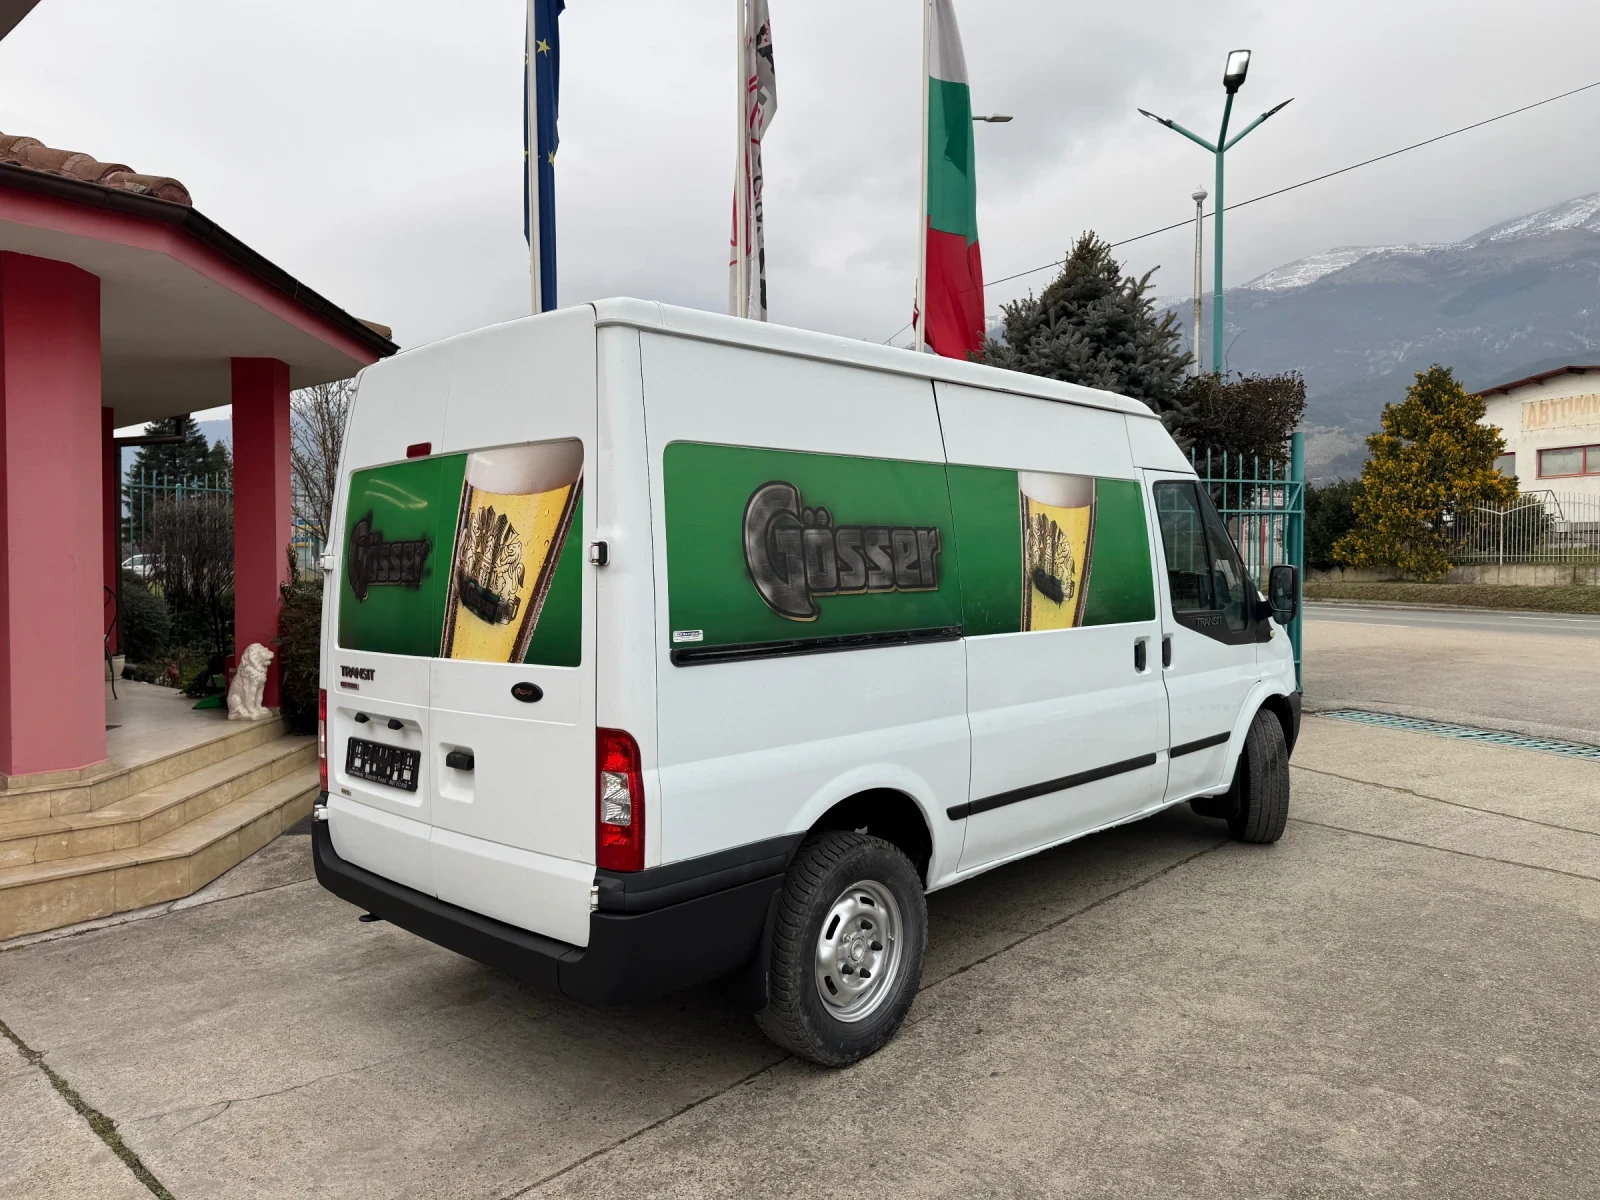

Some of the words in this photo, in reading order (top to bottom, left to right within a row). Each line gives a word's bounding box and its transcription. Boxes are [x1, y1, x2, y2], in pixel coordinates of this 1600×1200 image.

[743, 481, 940, 622] Gösser
[1195, 616, 1223, 627] TRANSIT
[340, 664, 376, 682] TRANSIT
